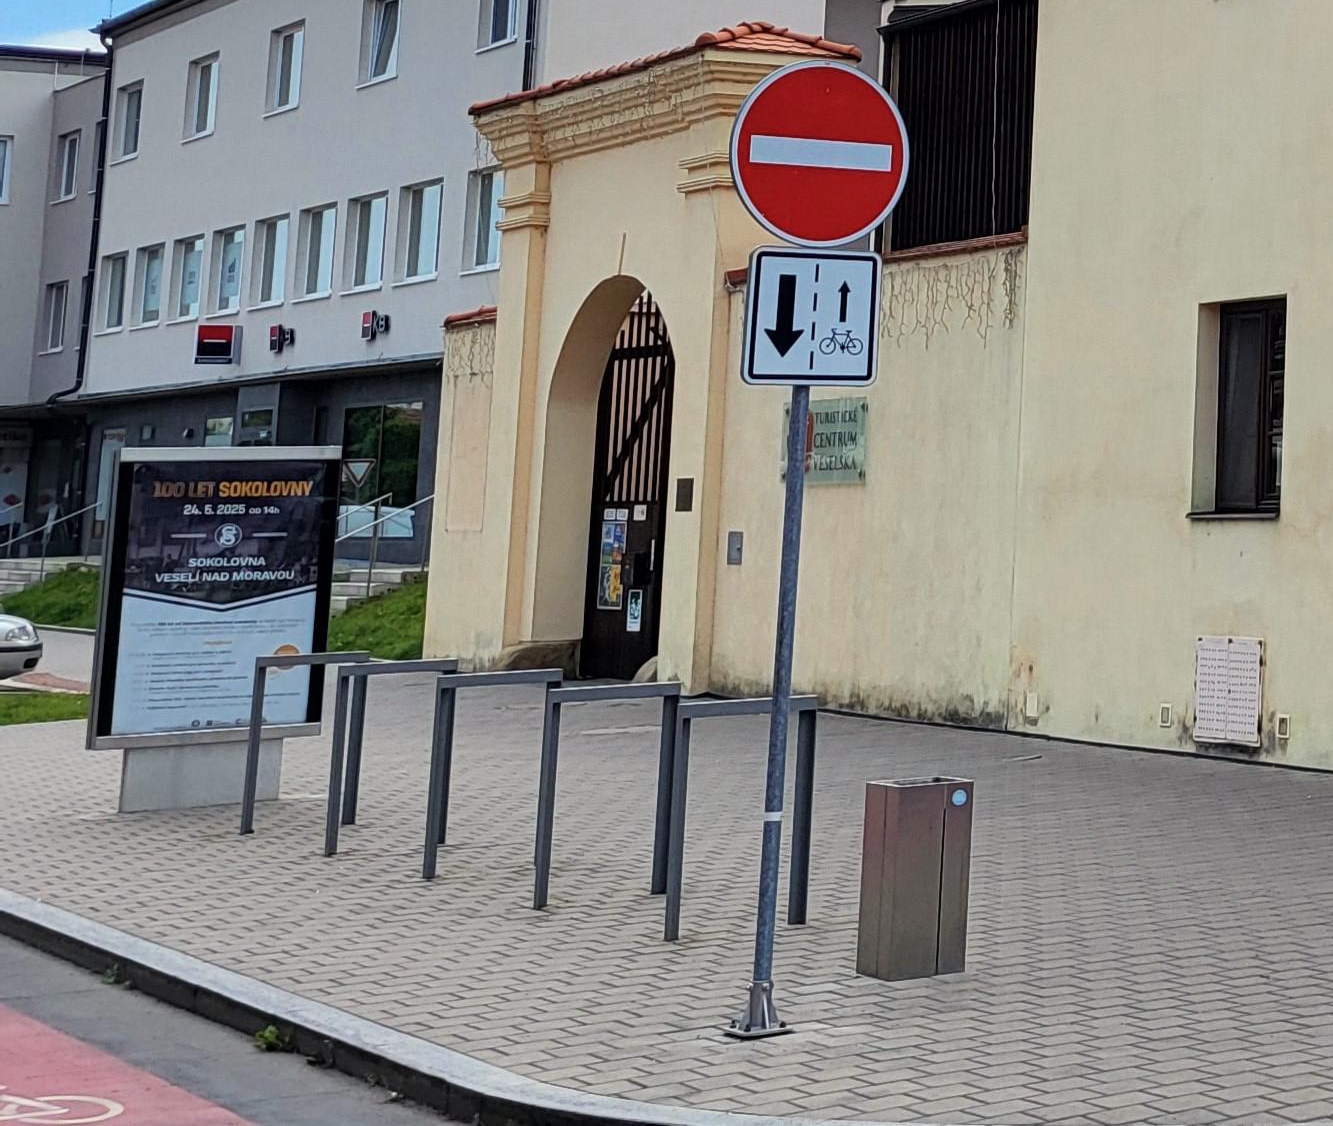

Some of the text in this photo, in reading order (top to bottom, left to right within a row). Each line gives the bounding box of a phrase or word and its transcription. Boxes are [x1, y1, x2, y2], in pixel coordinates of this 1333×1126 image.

[814, 407, 858, 425] TURISTICKÉ
[813, 430, 858, 448] CENTRUM
[813, 454, 857, 471] VESELSKA
[153, 480, 314, 498] 100 LET SOKOLOVNY
[183, 504, 202, 515] 24.
[216, 504, 246, 515] 2025
[188, 556, 266, 567] SOKOLOVNA
[155, 569, 295, 583] VESELÍ NAD MORAVOU
